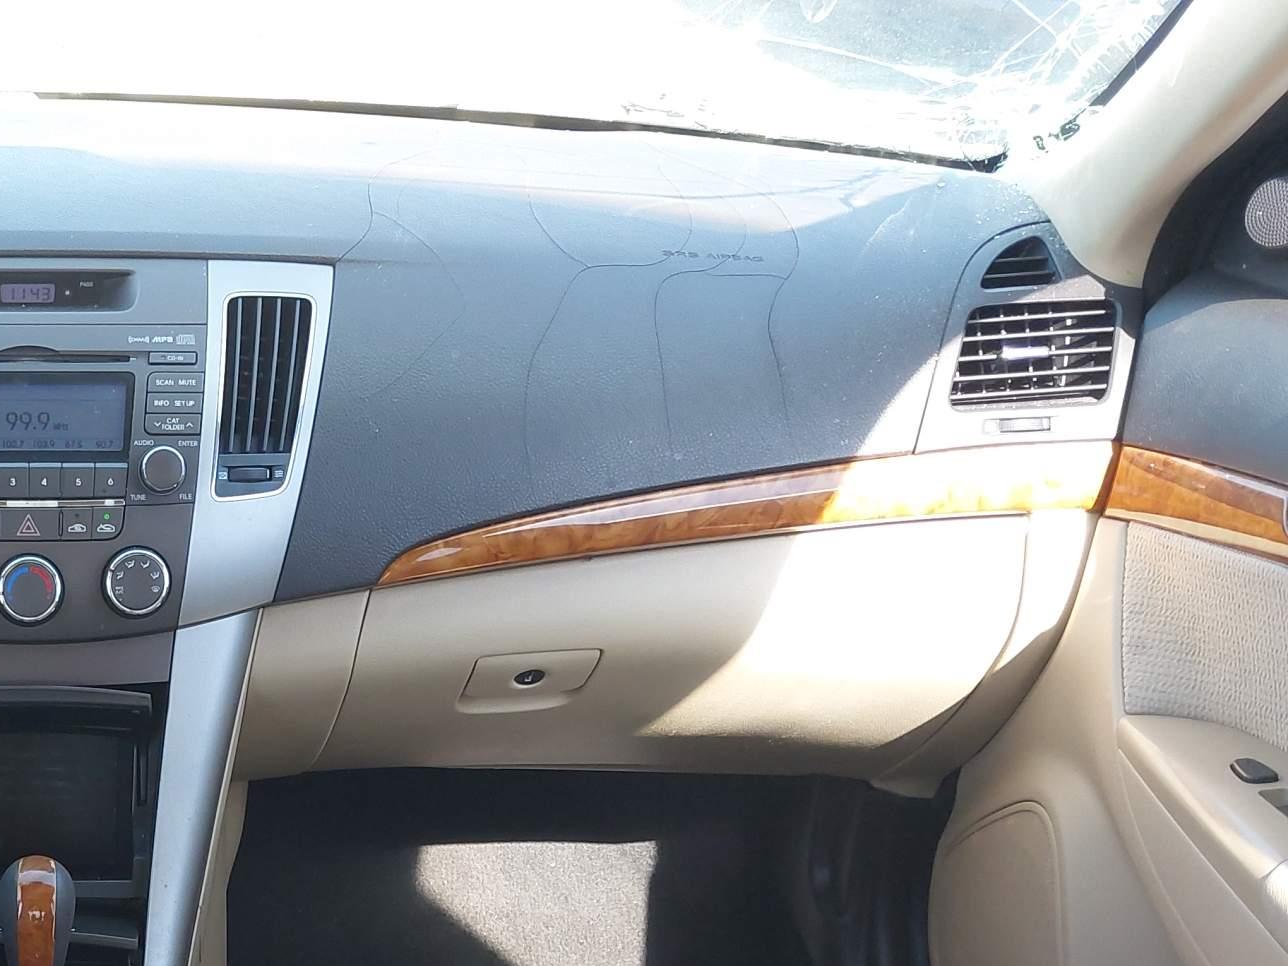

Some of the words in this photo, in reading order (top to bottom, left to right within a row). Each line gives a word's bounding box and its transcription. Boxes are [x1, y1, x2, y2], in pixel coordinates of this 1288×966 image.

[6, 412, 50, 431] 99.9
[10, 478, 16, 486] 3
[41, 478, 47, 486] 4
[75, 478, 82, 486] 5
[108, 478, 114, 486] 6
